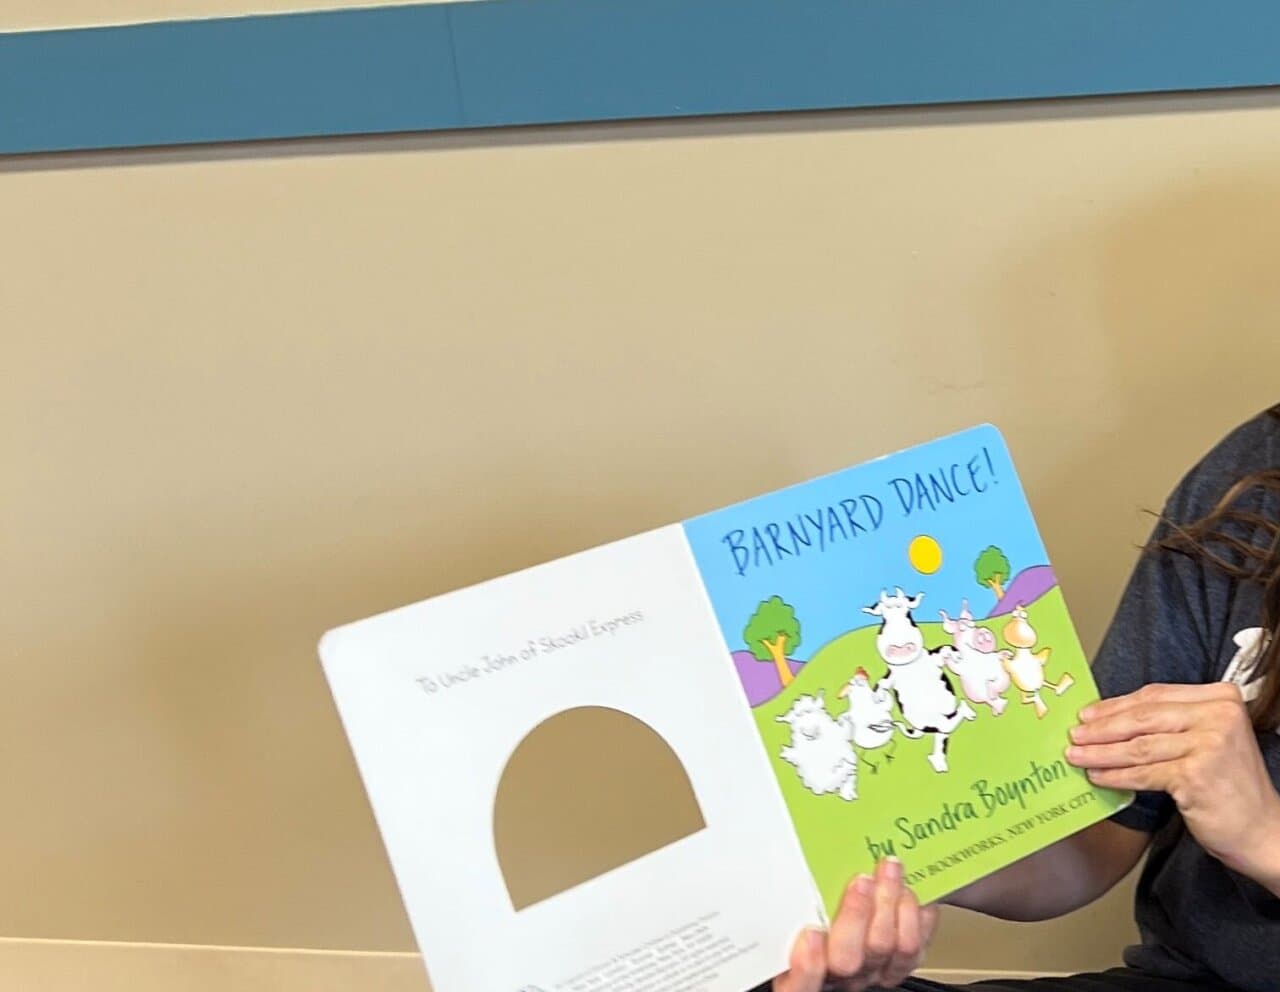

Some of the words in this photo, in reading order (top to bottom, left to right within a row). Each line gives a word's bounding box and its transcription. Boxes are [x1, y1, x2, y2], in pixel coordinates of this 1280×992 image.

[721, 494, 884, 577] BARNYARD
[888, 447, 999, 517] DANCE!
[439, 664, 480, 689] Uncle
[481, 654, 518, 674] John
[520, 639, 537, 662] of
[588, 610, 645, 636] Express
[894, 801, 980, 850] Sandra
[971, 757, 1068, 818] Boynton
[1005, 816, 1035, 838] NEW
[1034, 803, 1070, 825] YORK
[1068, 790, 1097, 810] CITY
